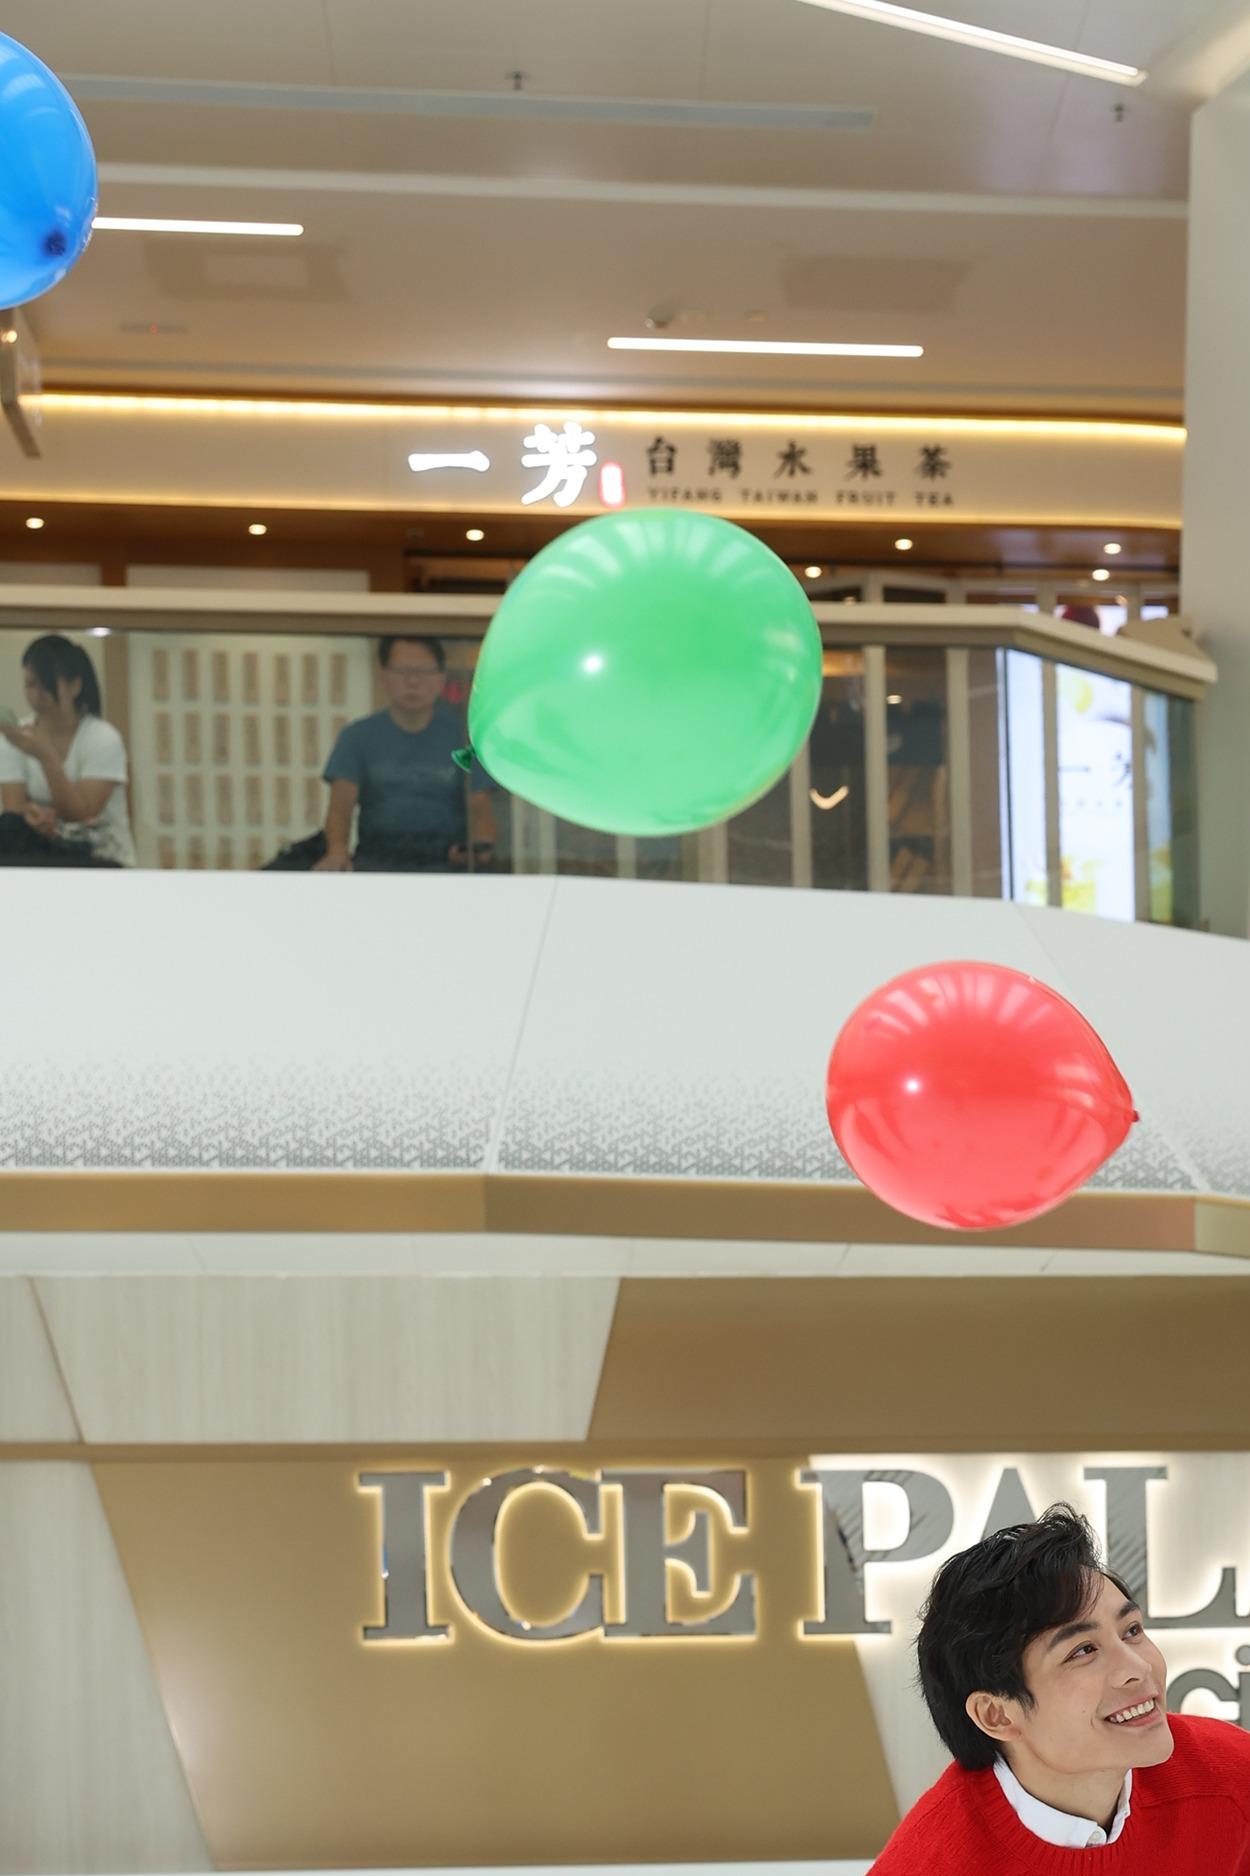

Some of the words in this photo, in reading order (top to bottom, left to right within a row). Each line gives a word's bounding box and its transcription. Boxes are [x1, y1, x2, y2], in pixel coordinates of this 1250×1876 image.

[408, 422, 597, 507] 一芳
[646, 436, 952, 481] 台灣水果茶
[648, 486, 722, 502] YIFANG
[741, 488, 818, 504] TAIWAN
[836, 490, 896, 505] FRUIT
[915, 491, 954, 507] TEA
[357, 1467, 758, 1641] ICE
